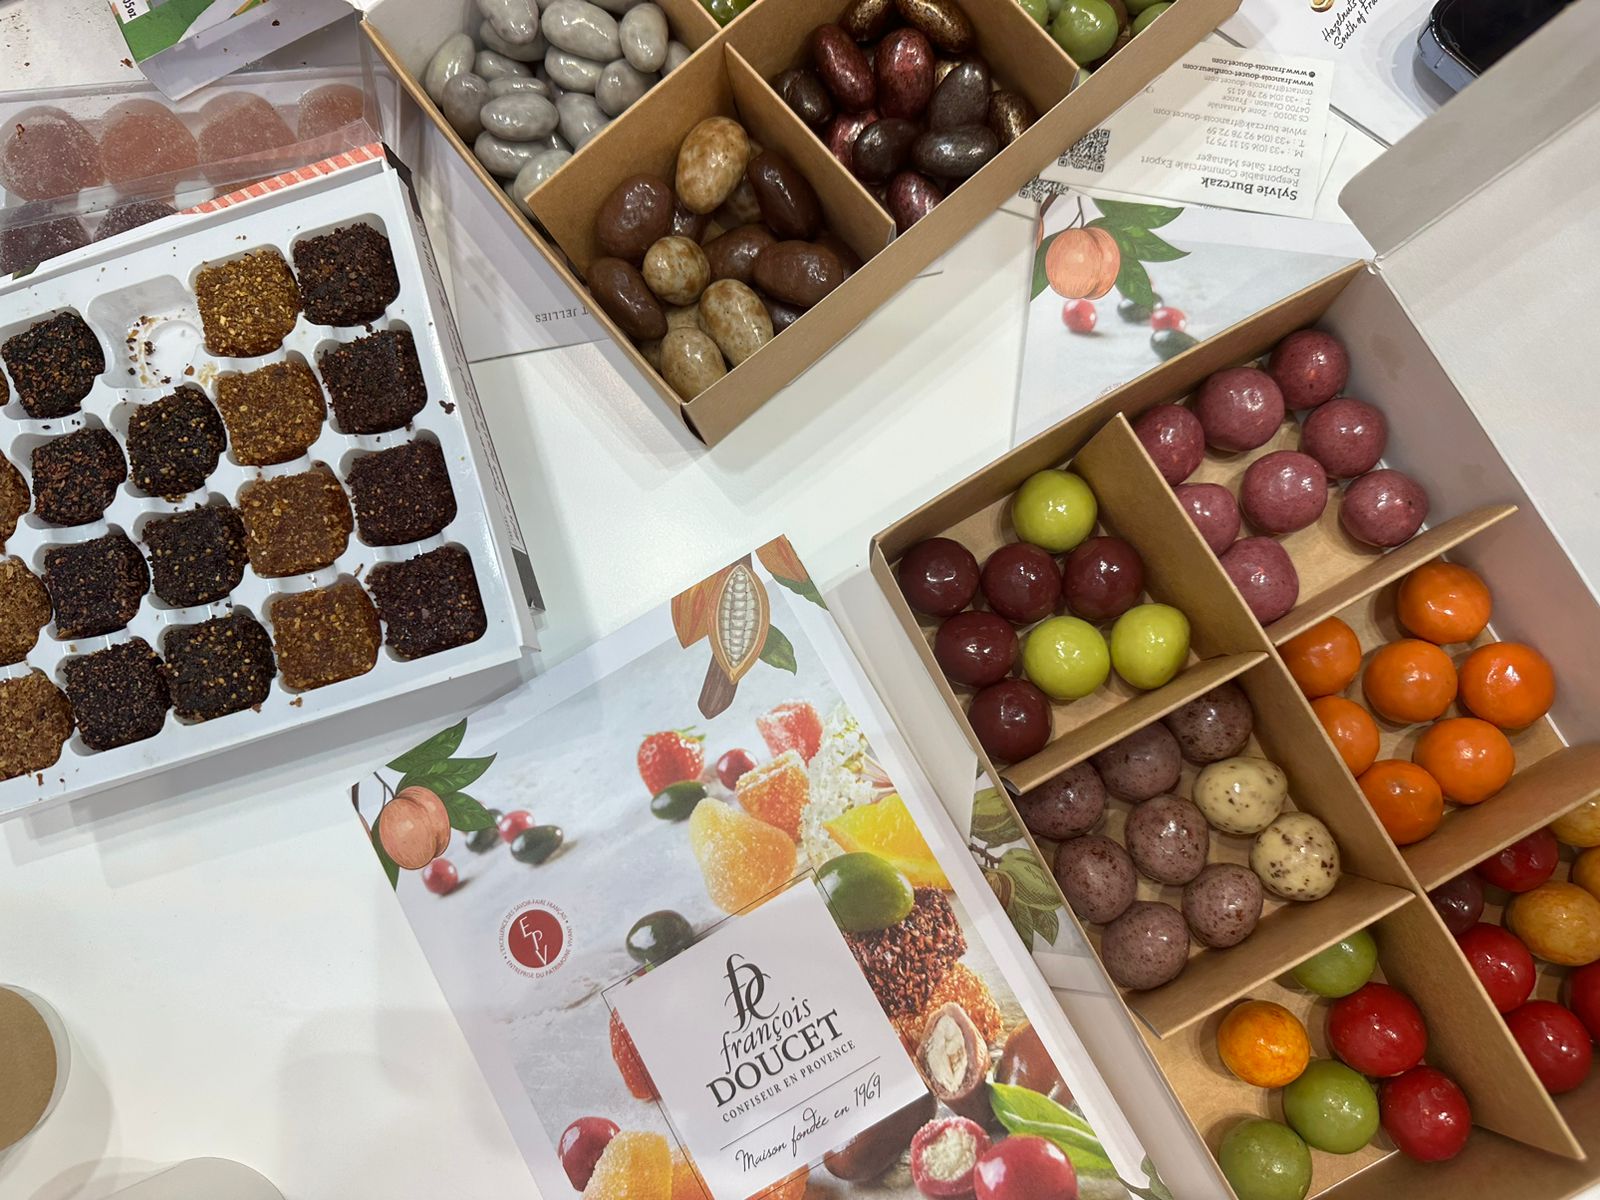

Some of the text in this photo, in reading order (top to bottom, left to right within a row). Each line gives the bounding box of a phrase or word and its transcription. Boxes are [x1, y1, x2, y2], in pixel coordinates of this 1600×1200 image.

[1321, 0, 1357, 42] Hazelnuts
[1333, 20, 1358, 50] South
[1356, 10, 1367, 24] of
[1208, 101, 1246, 113] Artisanale
[1222, 95, 1248, 106] France
[1254, 100, 1284, 110] Oraison
[1248, 108, 1267, 117] Zone
[1285, 104, 1310, 114] 04700
[1273, 111, 1297, 121] 30100
[1206, 126, 1217, 135] 59
[1219, 128, 1229, 137] 72
[1231, 130, 1242, 139] 78
[1244, 131, 1254, 140] 92
[1141, 155, 1299, 187] Responsable Commerciale Export
[1196, 153, 1301, 177] Export Sales Manager
[1201, 176, 1298, 201] Sylvie Burczak
[535, 308, 577, 323] JELLIES
[720, 996, 812, 1075] françois
[706, 1009, 843, 1107] DOUCET
[722, 1039, 856, 1123] CONFISEUR EN PROVENCE
[735, 1072, 881, 1172] Maison fondée en 1969
